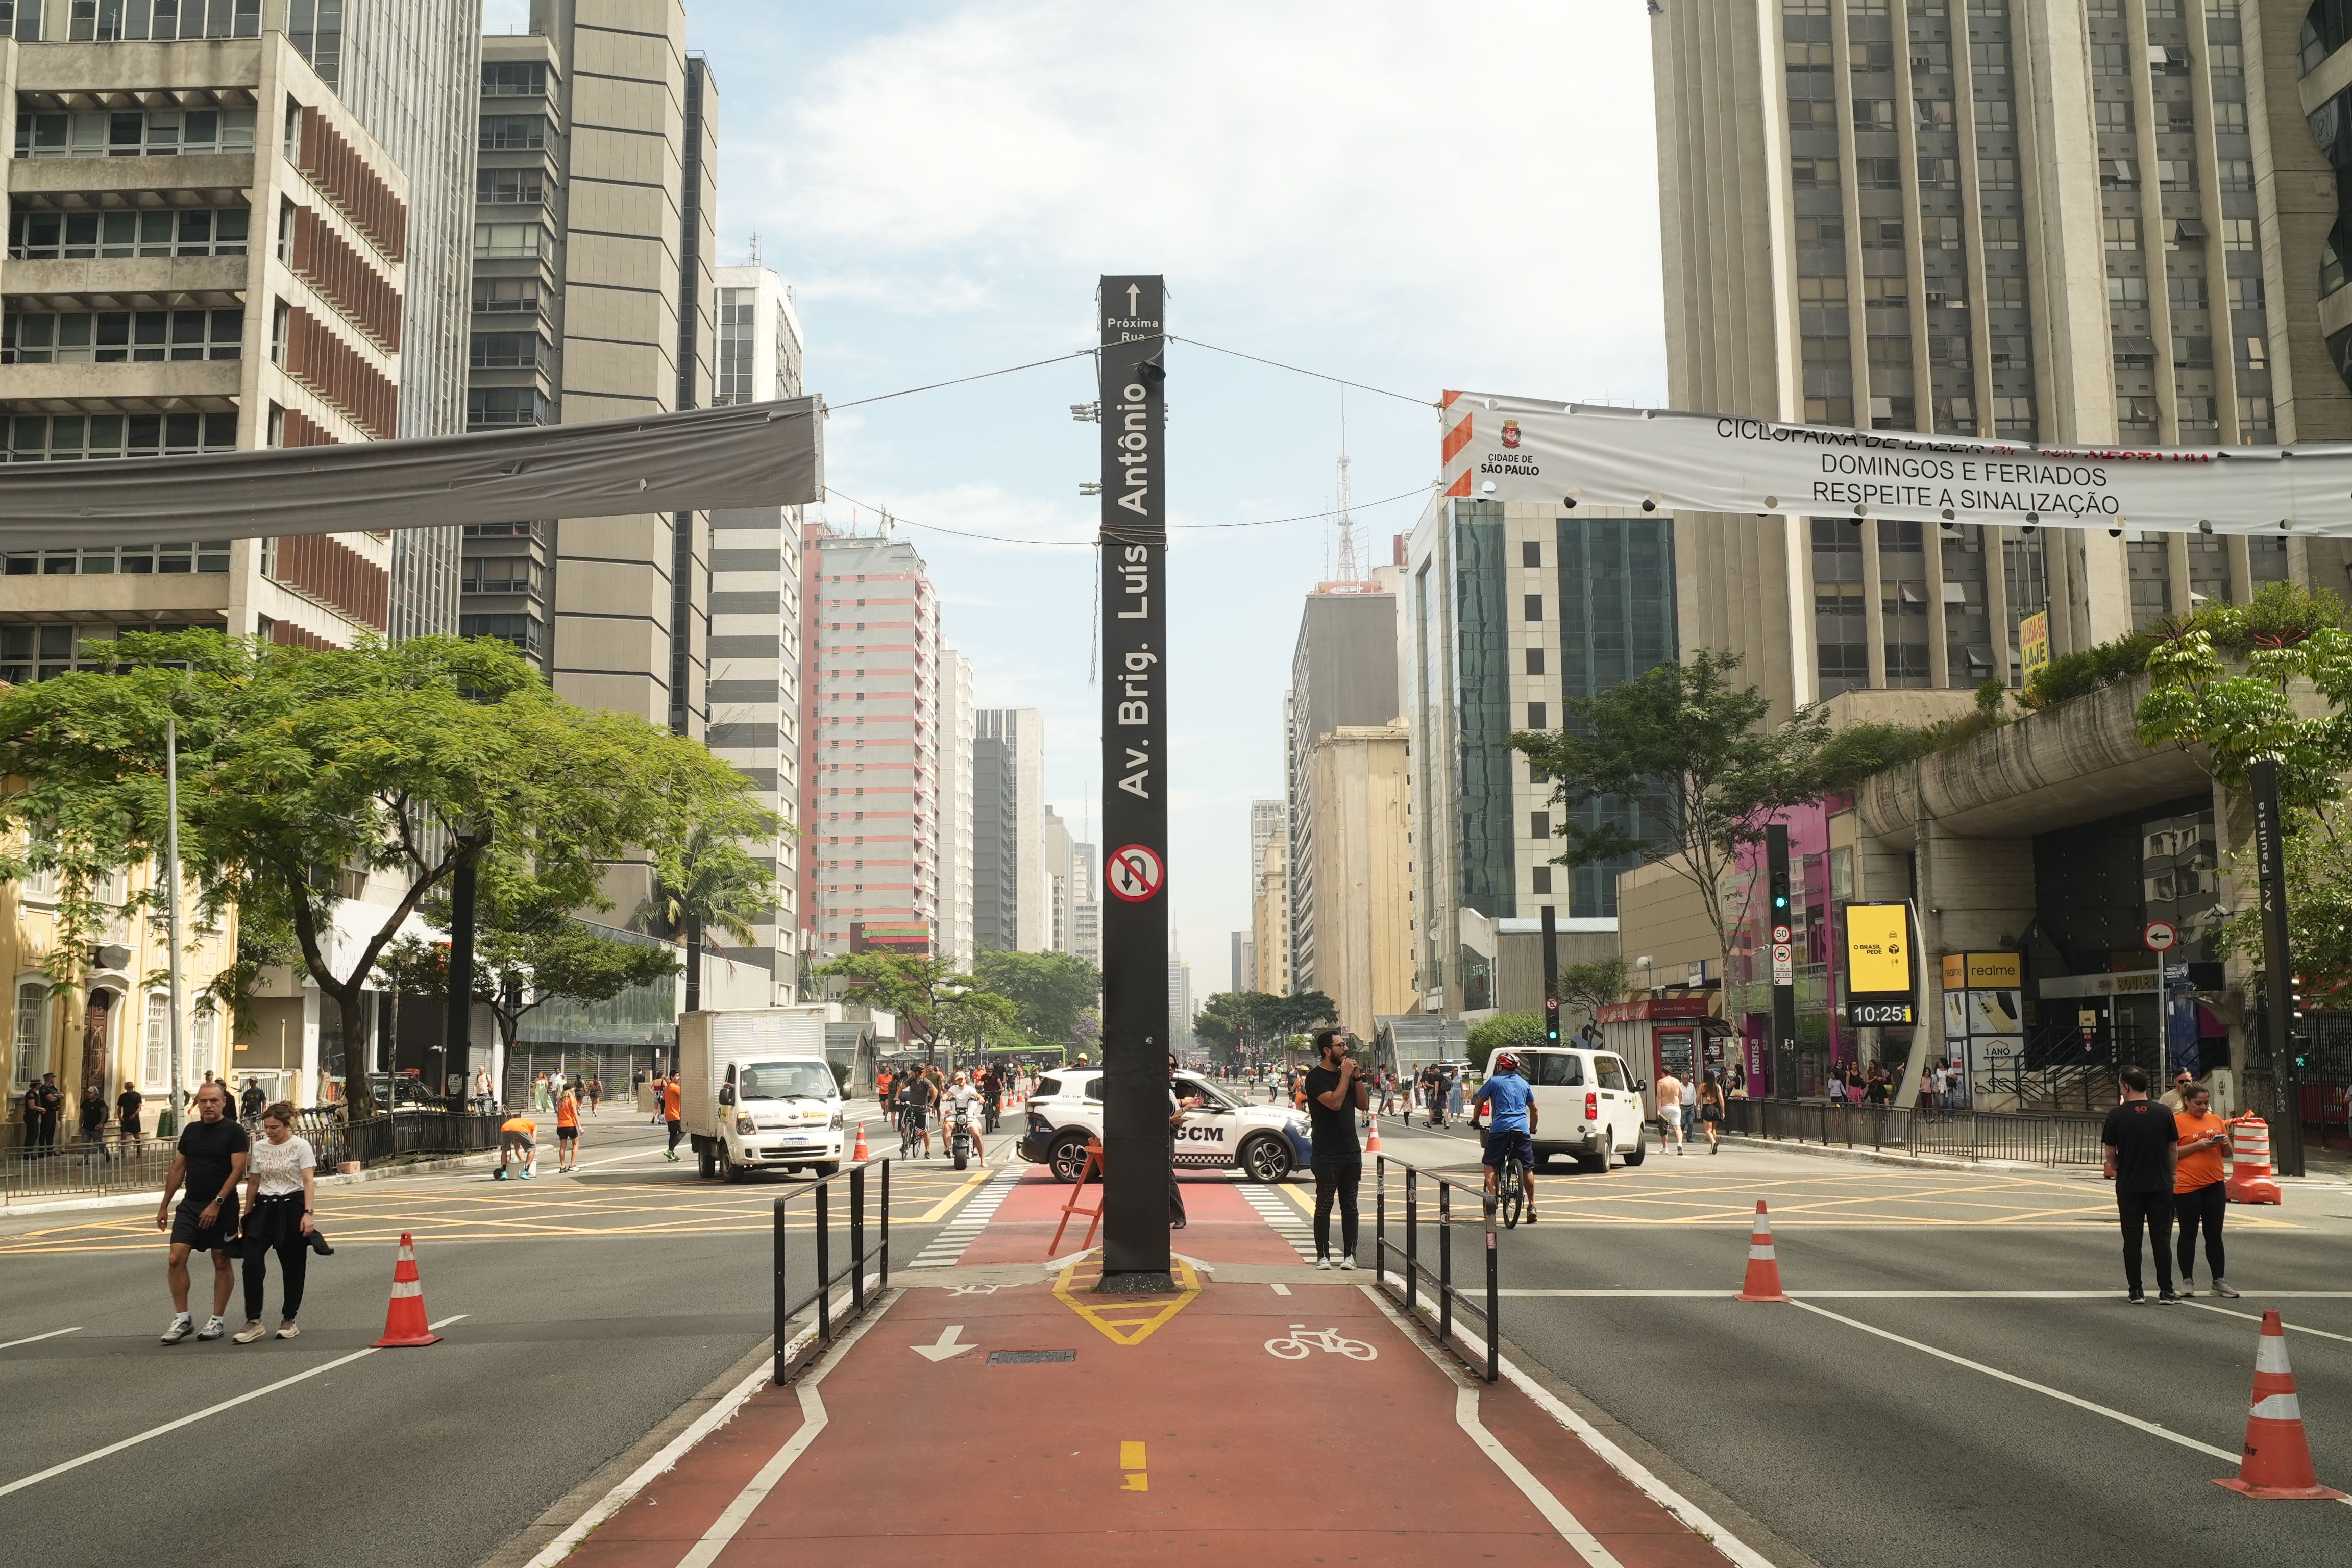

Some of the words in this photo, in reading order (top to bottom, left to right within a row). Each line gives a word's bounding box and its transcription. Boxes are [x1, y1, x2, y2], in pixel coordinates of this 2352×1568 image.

[1108, 318, 1159, 328] Próxima
[1121, 332, 1145, 341] Rua
[1116, 383, 1148, 516] Antônio
[1488, 453, 1519, 462] CIDADE
[1522, 455, 1533, 463] DE
[1481, 462, 1503, 474] SÃO
[1505, 465, 1539, 475] PAULO
[1822, 454, 1954, 480] DOMINGOS
[1963, 462, 1977, 481] E
[1985, 463, 2107, 486] FERIADOS
[1814, 481, 1932, 506] RESPEITE
[1939, 488, 1955, 507] A
[1961, 489, 2119, 519] SINALIZAÇÃO
[1118, 545, 1148, 618] Luís
[2022, 615, 2045, 646] ALUGA-SE
[2024, 641, 2046, 669] LAJE
[1118, 643, 1158, 725] Brig.
[1118, 739, 1149, 799] Av.
[2258, 802, 2269, 874] Paulista
[2264, 884, 2272, 912] Av.
[1945, 967, 1962, 977] realme
[1972, 965, 2016, 976] realme
[1855, 1006, 1902, 1022] 10:25
[1751, 1039, 1760, 1074] marisa
[1175, 1126, 1224, 1141] GCM
